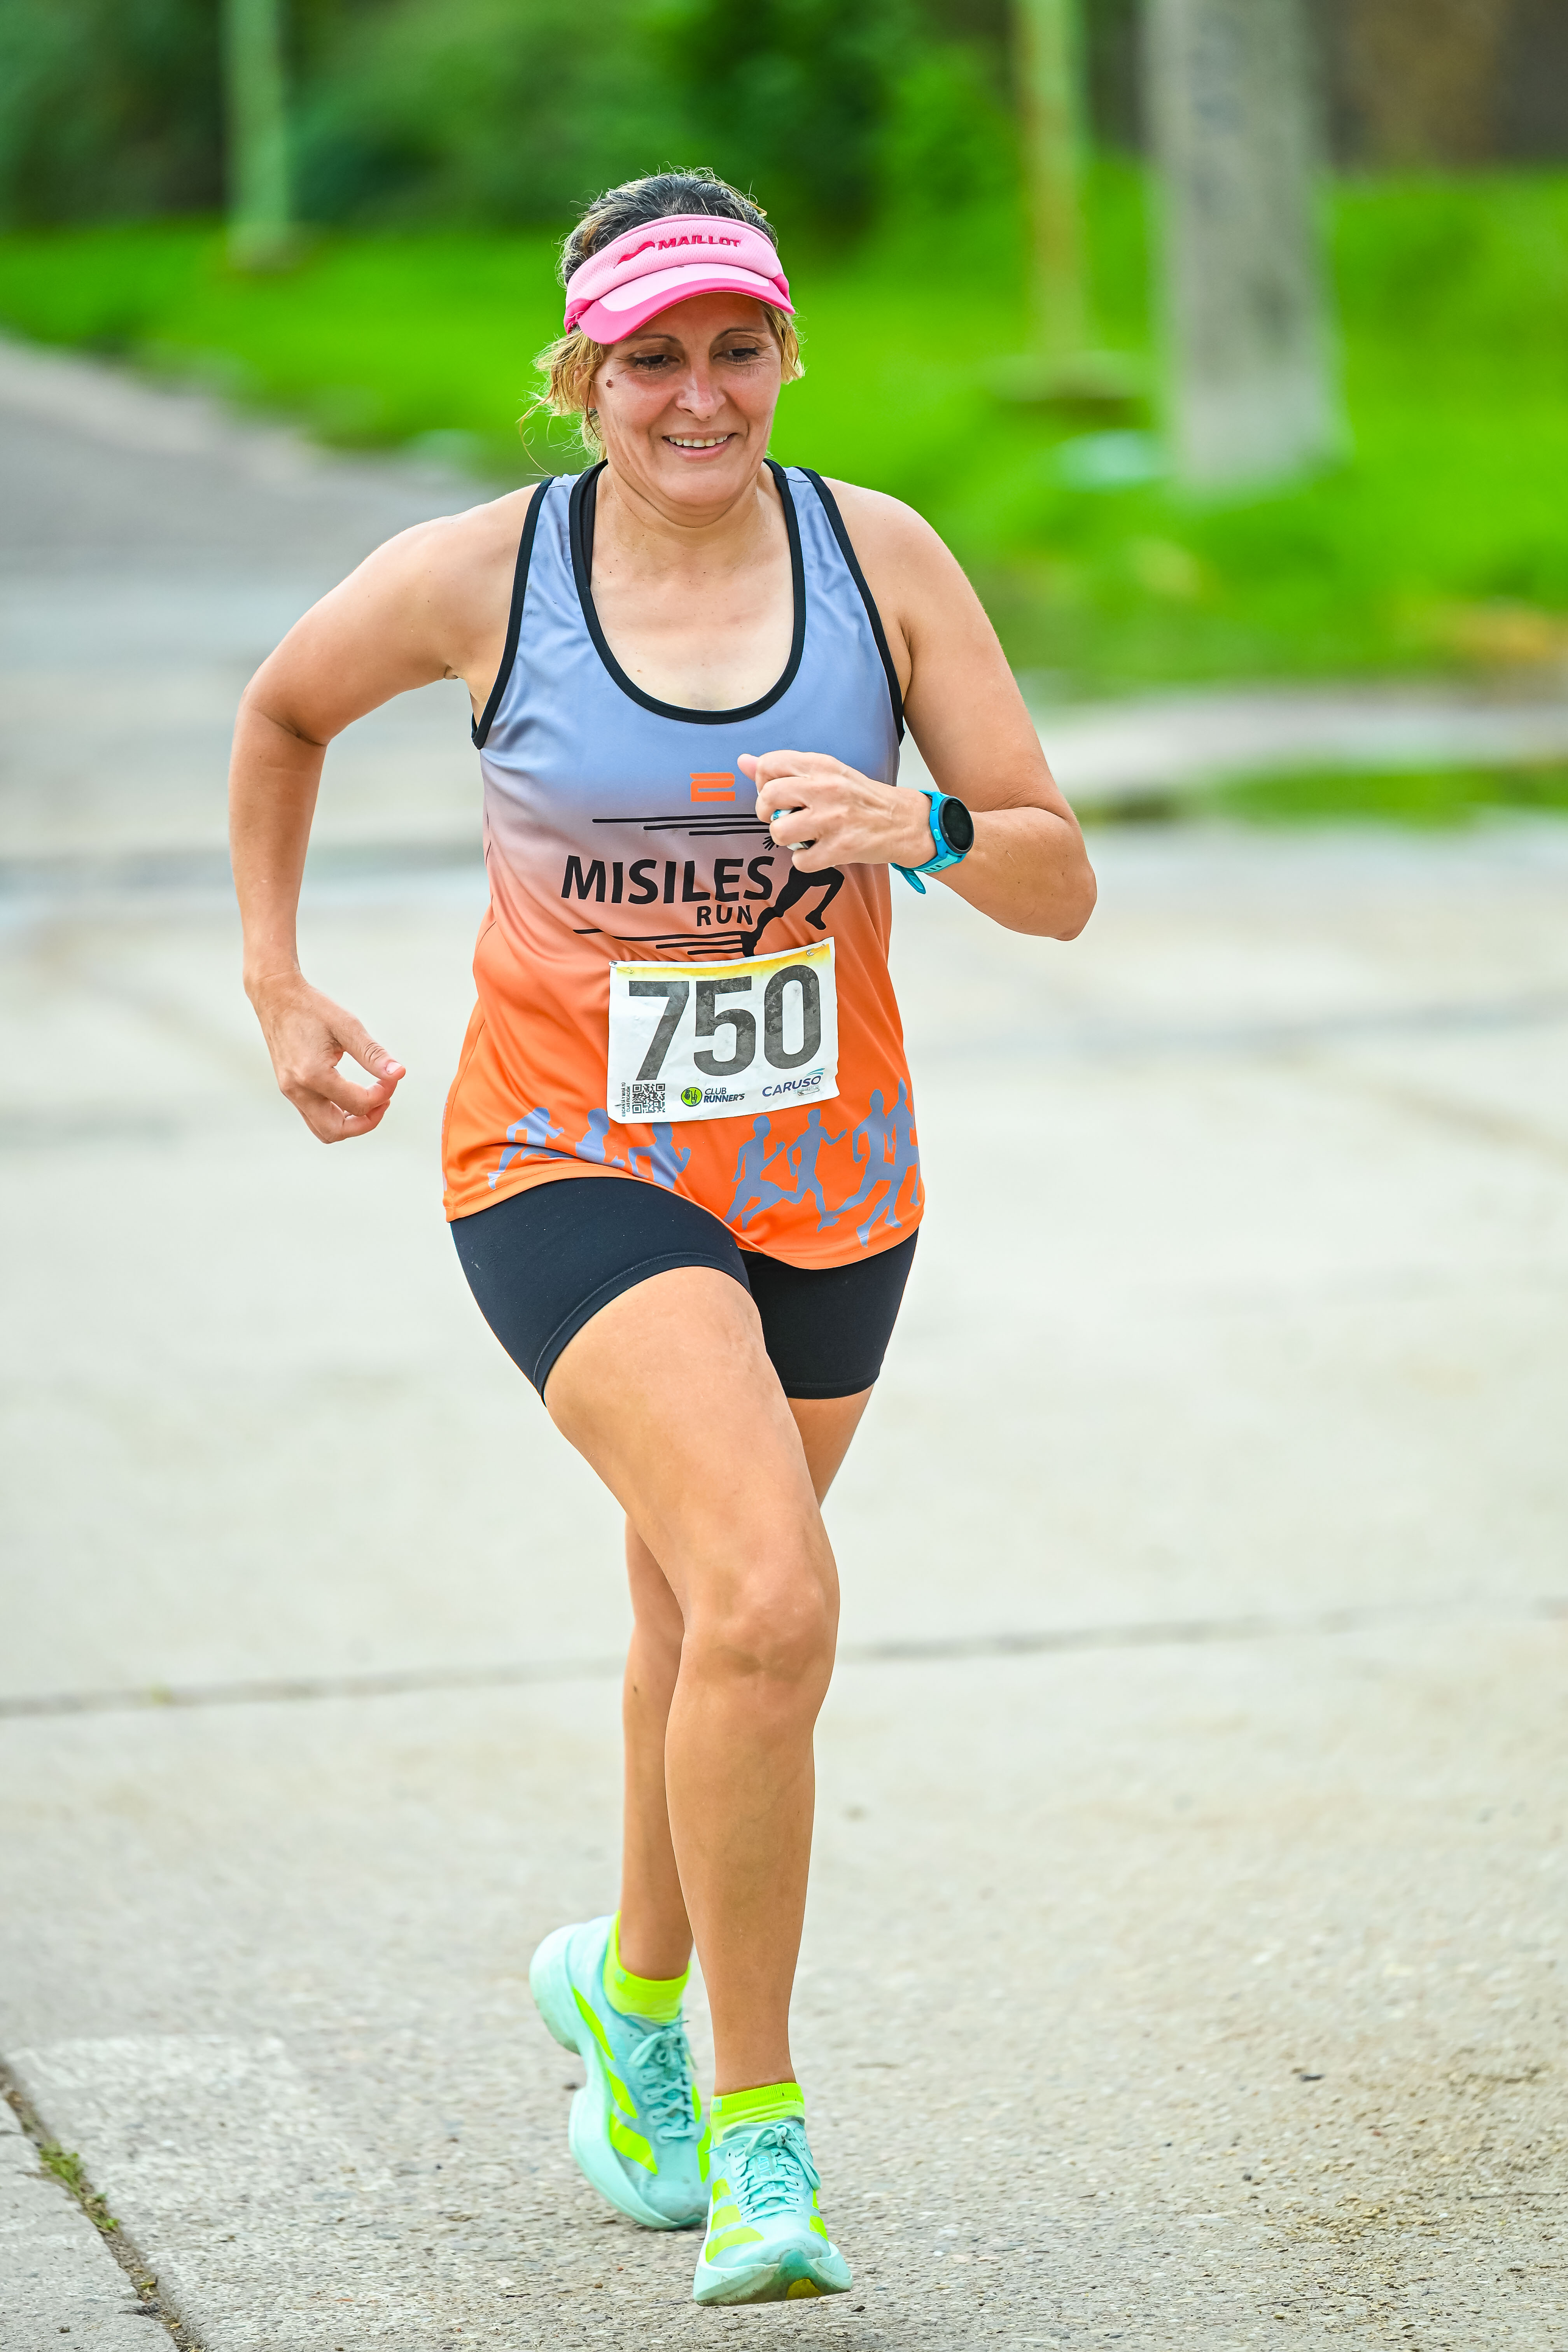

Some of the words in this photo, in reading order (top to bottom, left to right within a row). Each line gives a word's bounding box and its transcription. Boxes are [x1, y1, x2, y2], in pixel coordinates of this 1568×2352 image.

[658, 235, 742, 250] MAILLOT
[561, 855, 775, 904] MISILES
[696, 905, 753, 927] RUN
[629, 965, 821, 1080] 750
[762, 1076, 821, 1097] CARUSO
[704, 1094, 745, 1102] RUNNER'S
